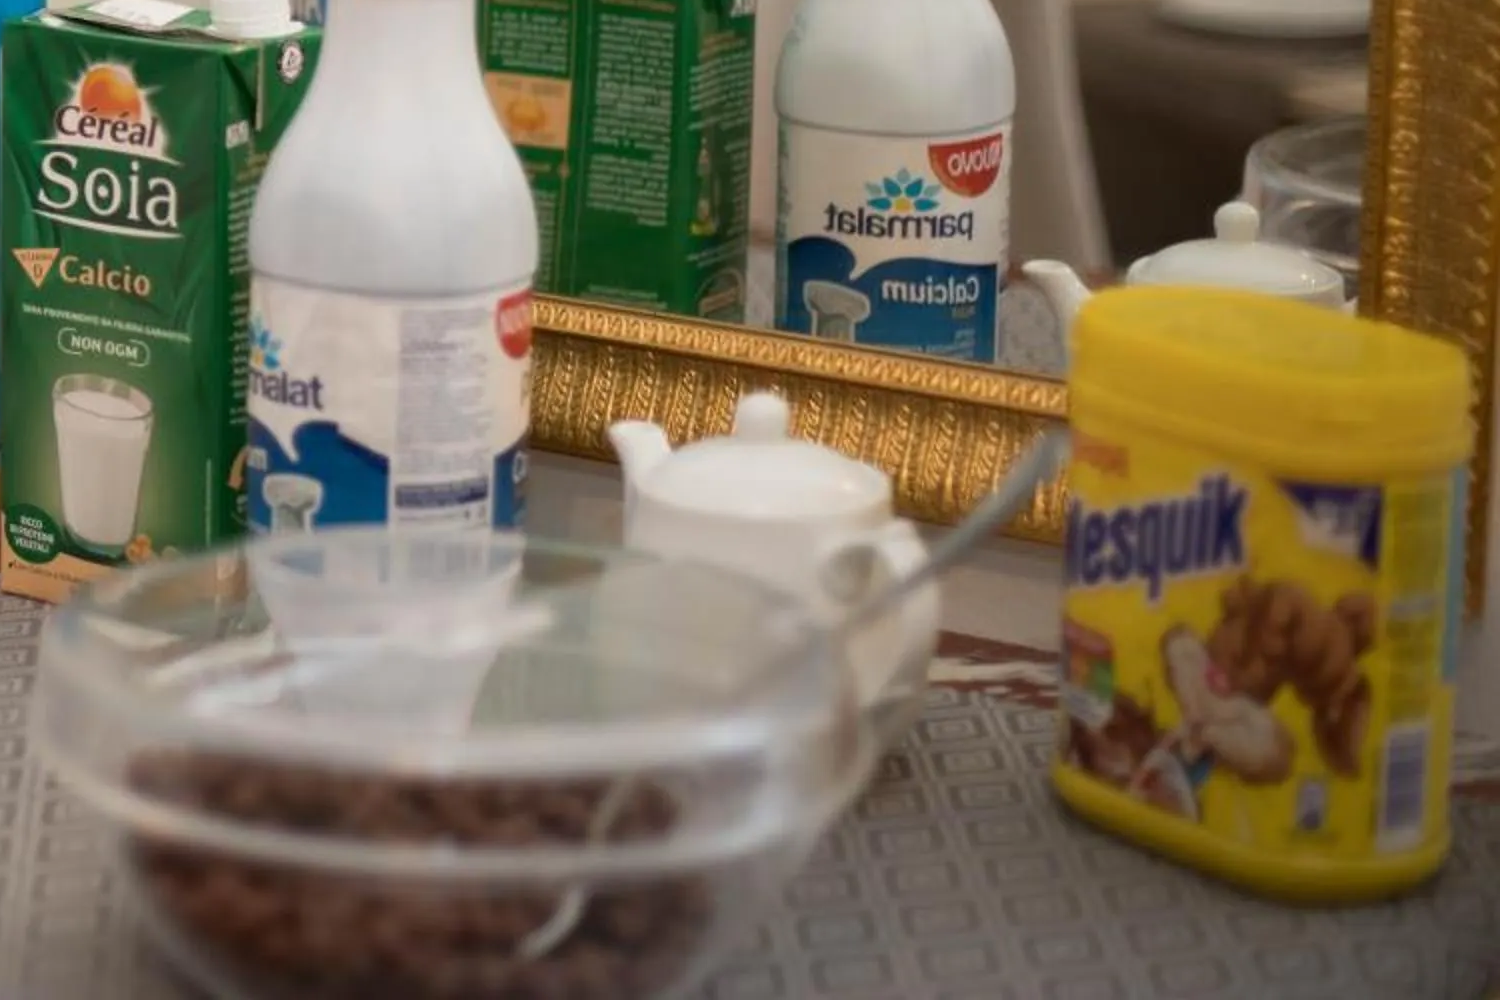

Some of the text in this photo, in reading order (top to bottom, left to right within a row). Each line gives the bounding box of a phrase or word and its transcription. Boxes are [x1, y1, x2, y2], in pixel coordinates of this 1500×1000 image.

[56, 105, 158, 148] Céréal
[37, 151, 179, 229] Soia
[59, 255, 151, 297] Calcio
[70, 334, 138, 360] NON OGM
